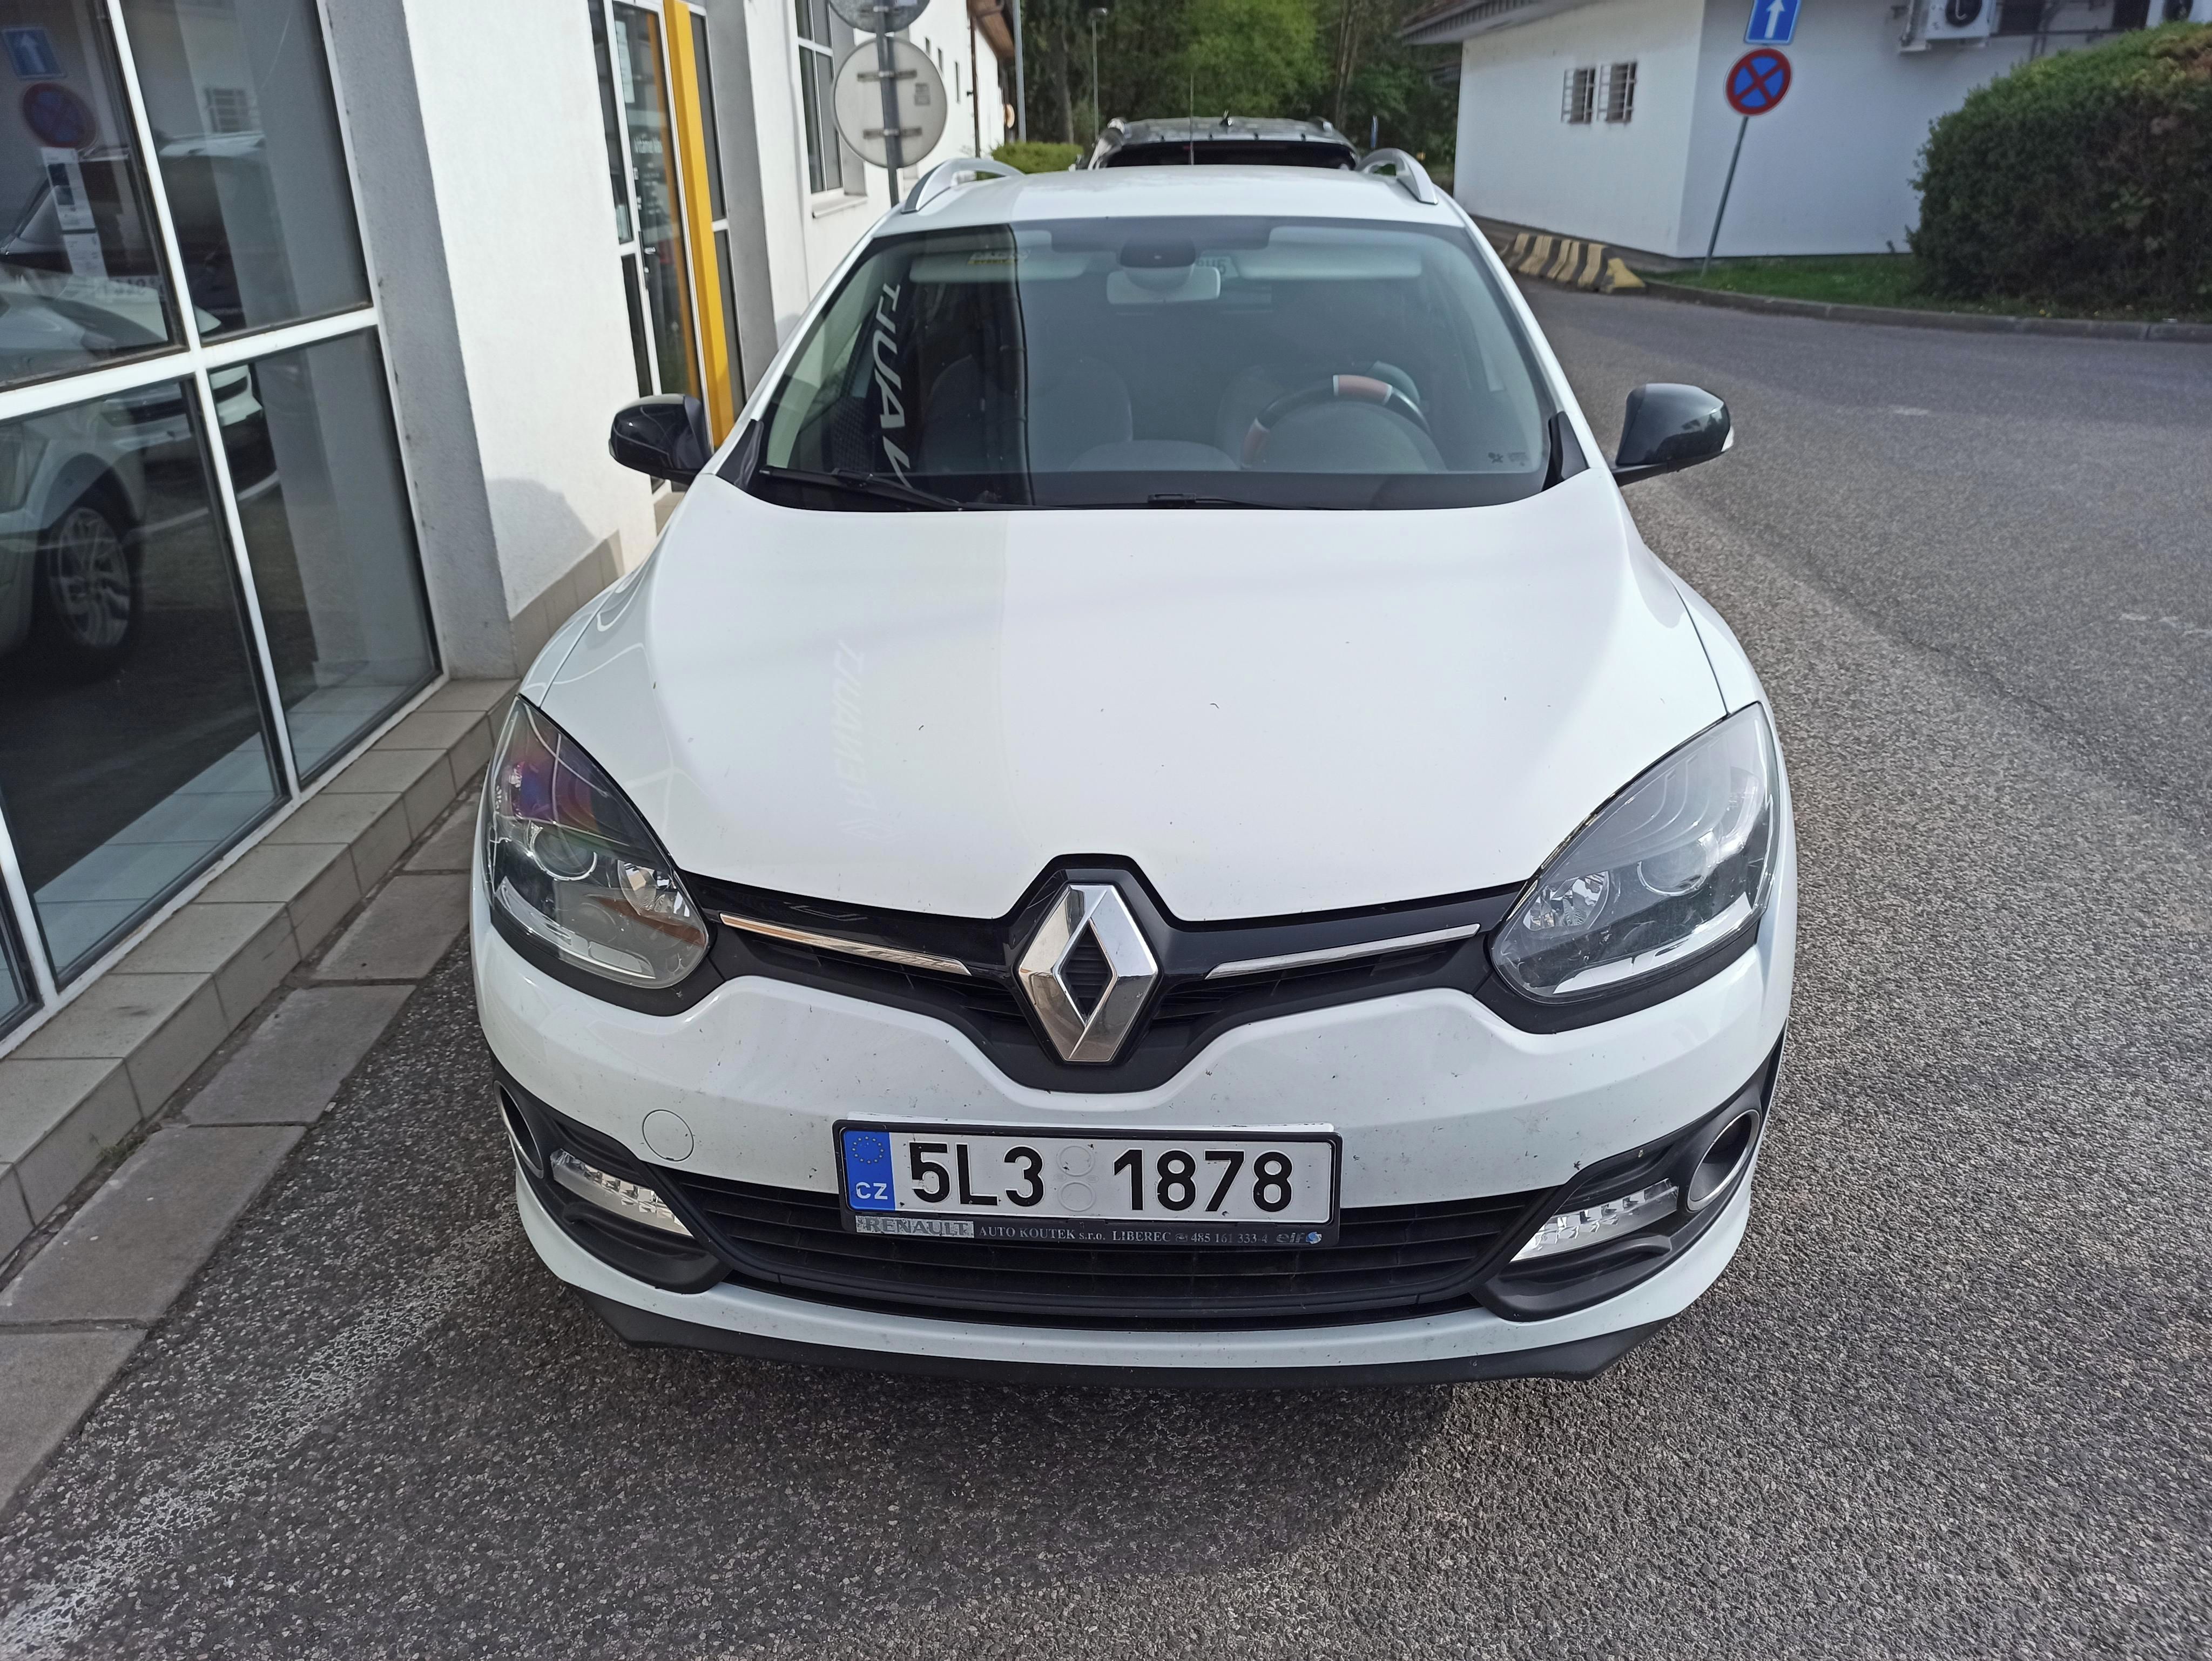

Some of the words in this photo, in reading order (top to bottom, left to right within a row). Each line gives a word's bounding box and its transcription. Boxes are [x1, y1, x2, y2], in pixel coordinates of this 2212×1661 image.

[908, 1141, 1044, 1207] 5L3
[1113, 1149, 1293, 1212] 1878
[855, 1181, 888, 1200] CZ
[864, 1217, 969, 1236] RENAULT
[979, 1226, 1016, 1238] AUTO
[1020, 1227, 1076, 1240] KOUTEK
[1079, 1231, 1106, 1240] s.r.o.
[1112, 1231, 1171, 1242] LIBEREC
[1191, 1231, 1211, 1243] 485
[1215, 1232, 1232, 1243] 161
